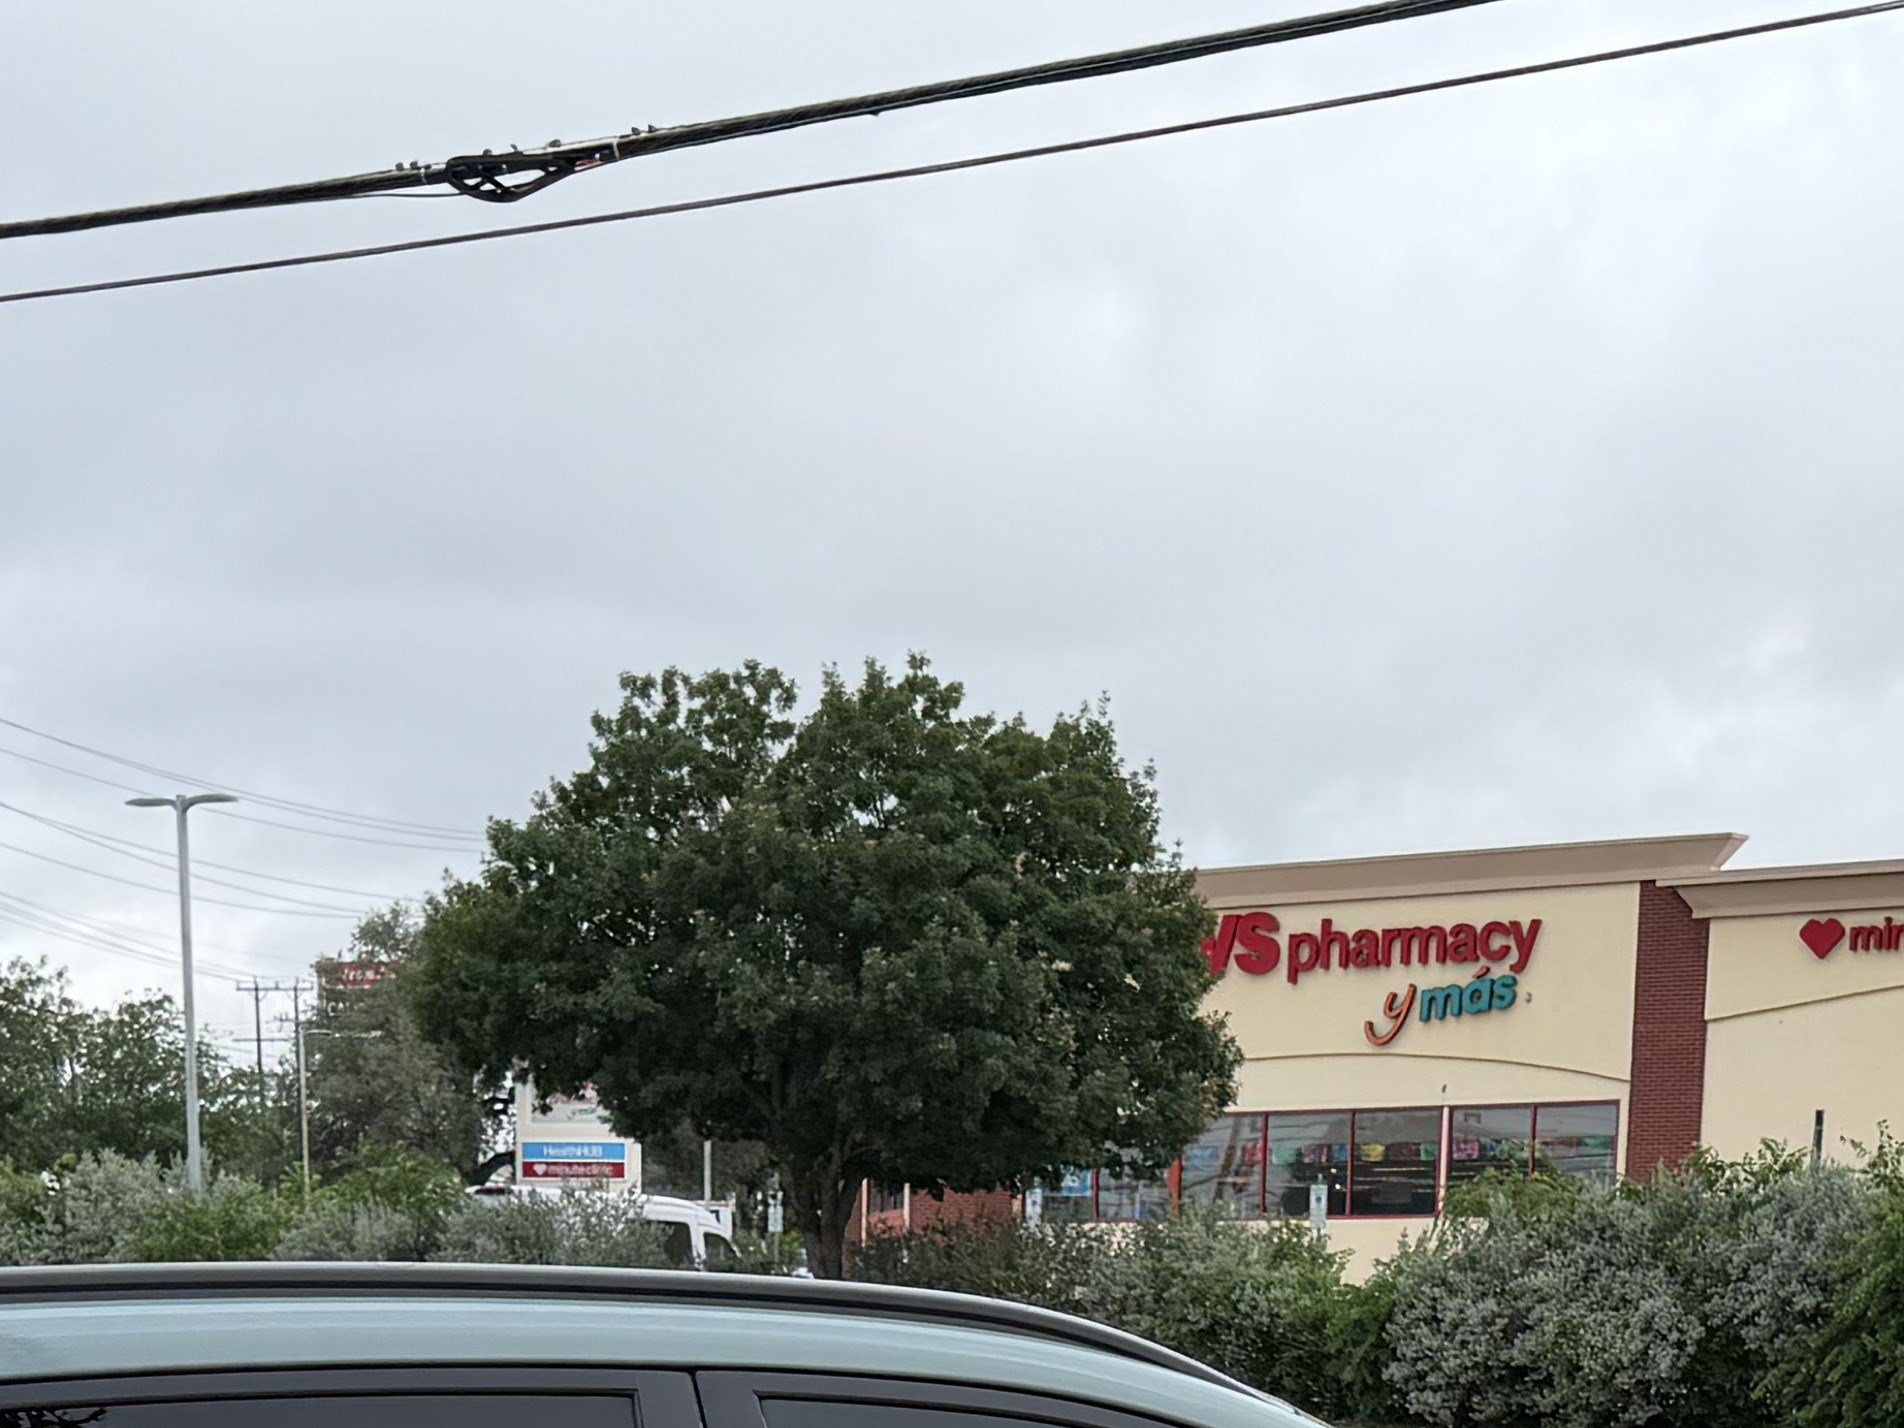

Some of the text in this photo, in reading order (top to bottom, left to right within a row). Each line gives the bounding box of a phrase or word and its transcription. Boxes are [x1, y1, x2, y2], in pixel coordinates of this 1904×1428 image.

[1201, 911, 1542, 985] VS pharmacy
[1364, 966, 1517, 1046] y más
